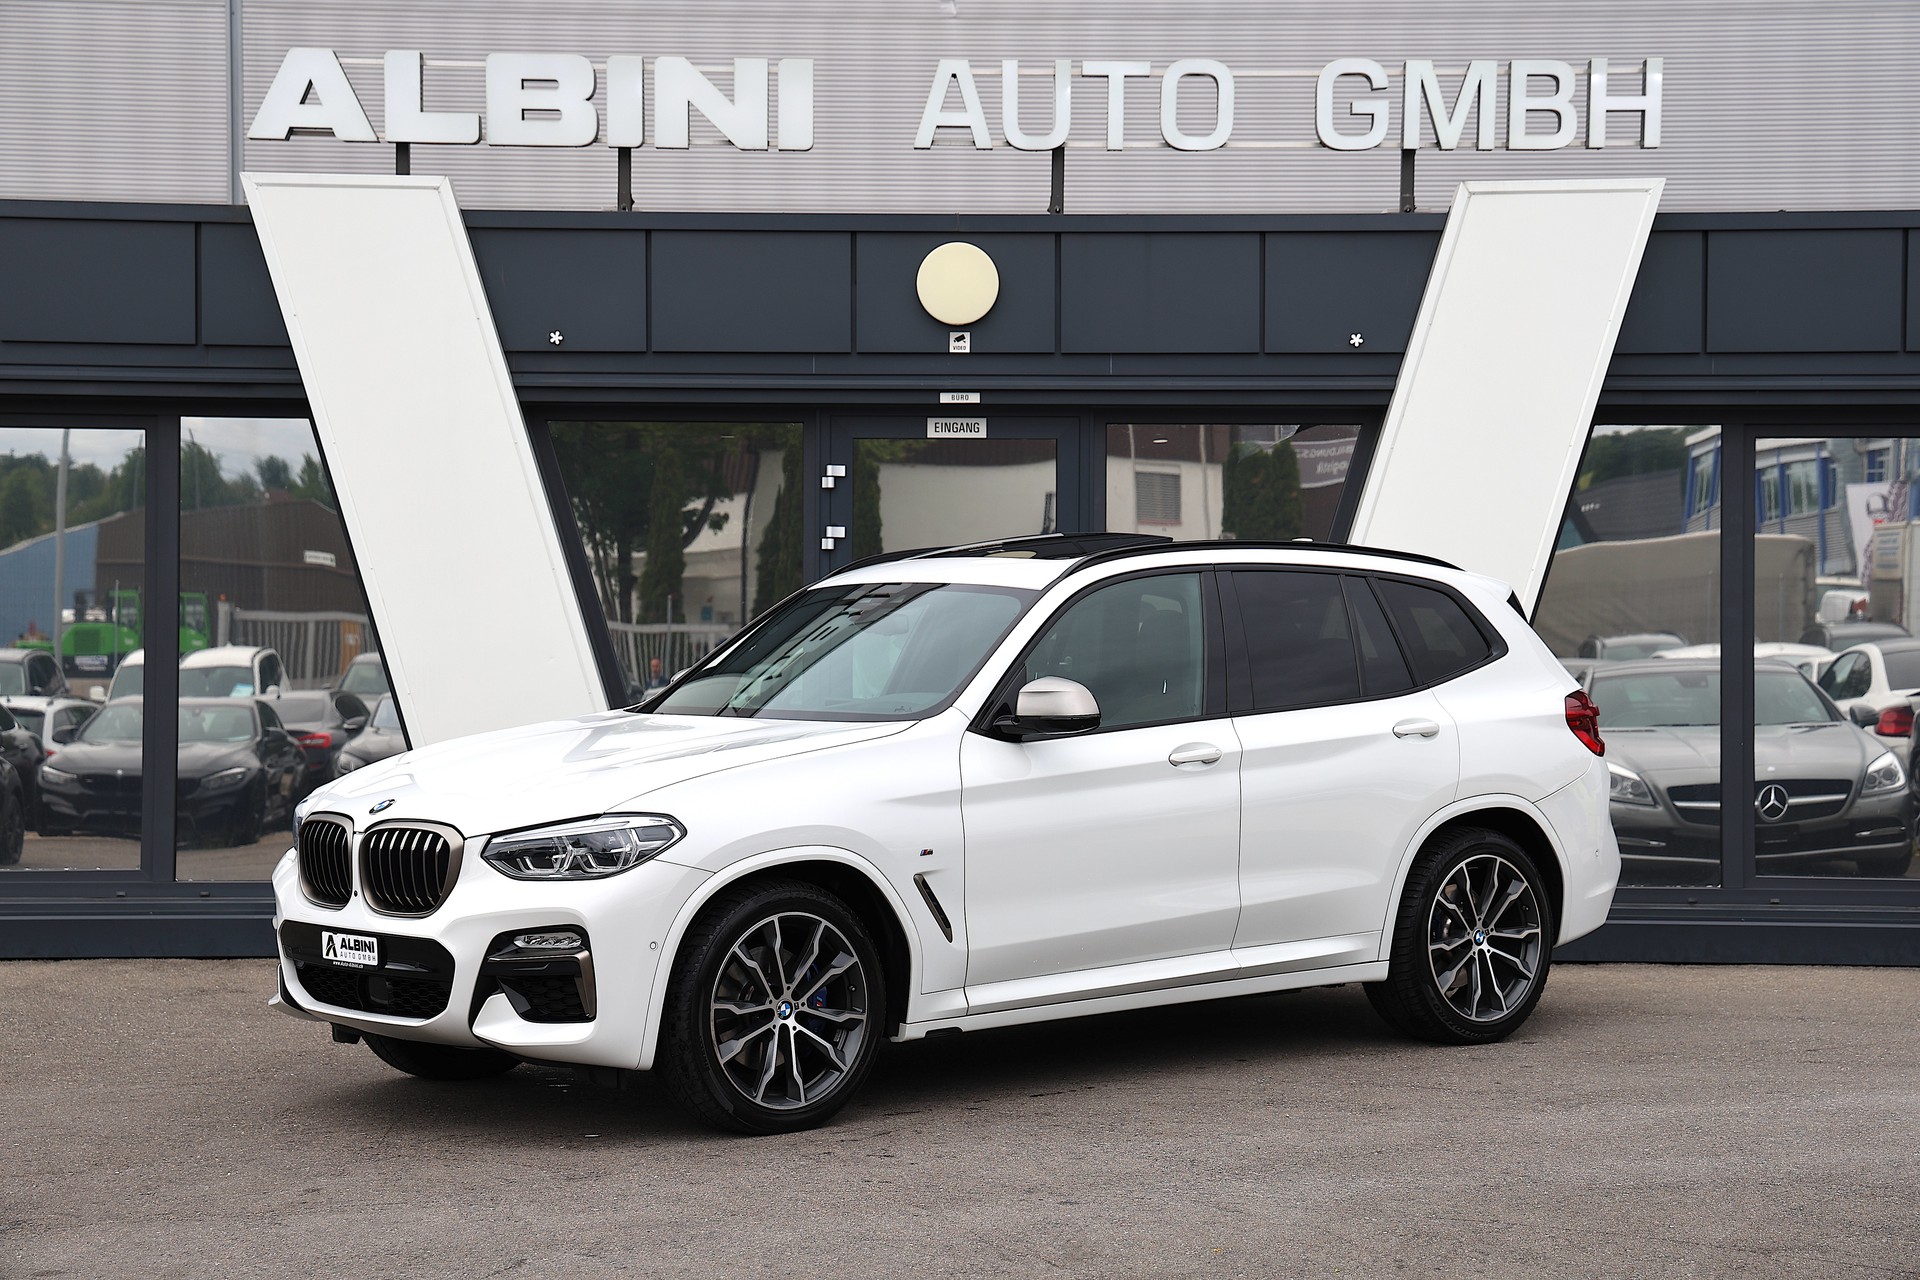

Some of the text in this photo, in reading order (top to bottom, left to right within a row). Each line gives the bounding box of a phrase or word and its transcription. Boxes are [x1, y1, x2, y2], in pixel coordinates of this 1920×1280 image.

[248, 47, 1663, 151] ALBINI AUTO GMBH
[951, 393, 969, 401] BÜRO
[934, 421, 980, 433] EINGANG
[340, 937, 375, 953] ALBINI
